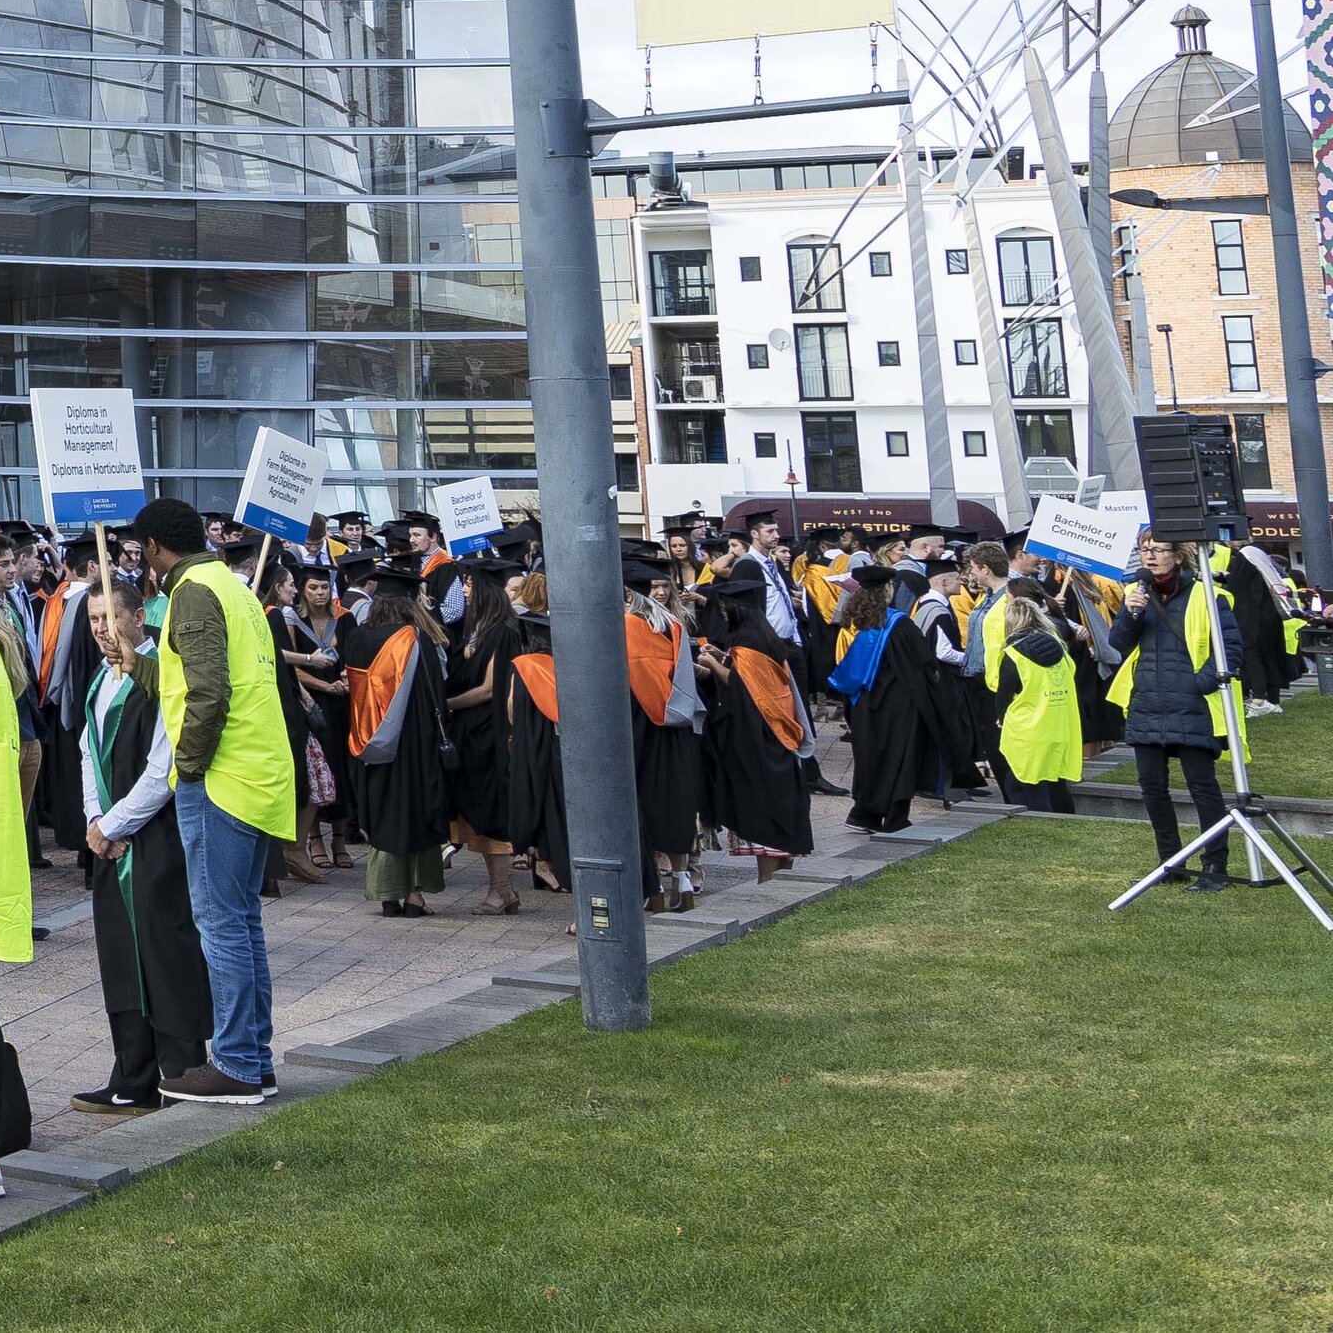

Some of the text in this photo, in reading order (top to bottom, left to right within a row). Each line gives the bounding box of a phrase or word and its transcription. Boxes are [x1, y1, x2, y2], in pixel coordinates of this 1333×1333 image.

[66, 405, 108, 420] Diploma in
[65, 421, 113, 435] Horticultural
[64, 439, 114, 454] Management
[279, 450, 301, 468] Diploma
[51, 461, 137, 478] Diploma in Horticulture
[266, 458, 314, 486] Farm Management
[267, 473, 278, 484] and
[277, 476, 300, 494] Diploma
[268, 486, 298, 505] Agriculture
[450, 492, 476, 505] Bachelor
[454, 503, 486, 517] Commerce
[1104, 505, 1138, 513] Masters
[454, 511, 491, 529] (Agriculture)
[1053, 513, 1118, 541] Bachelor of
[1051, 524, 1113, 551] Commerce
